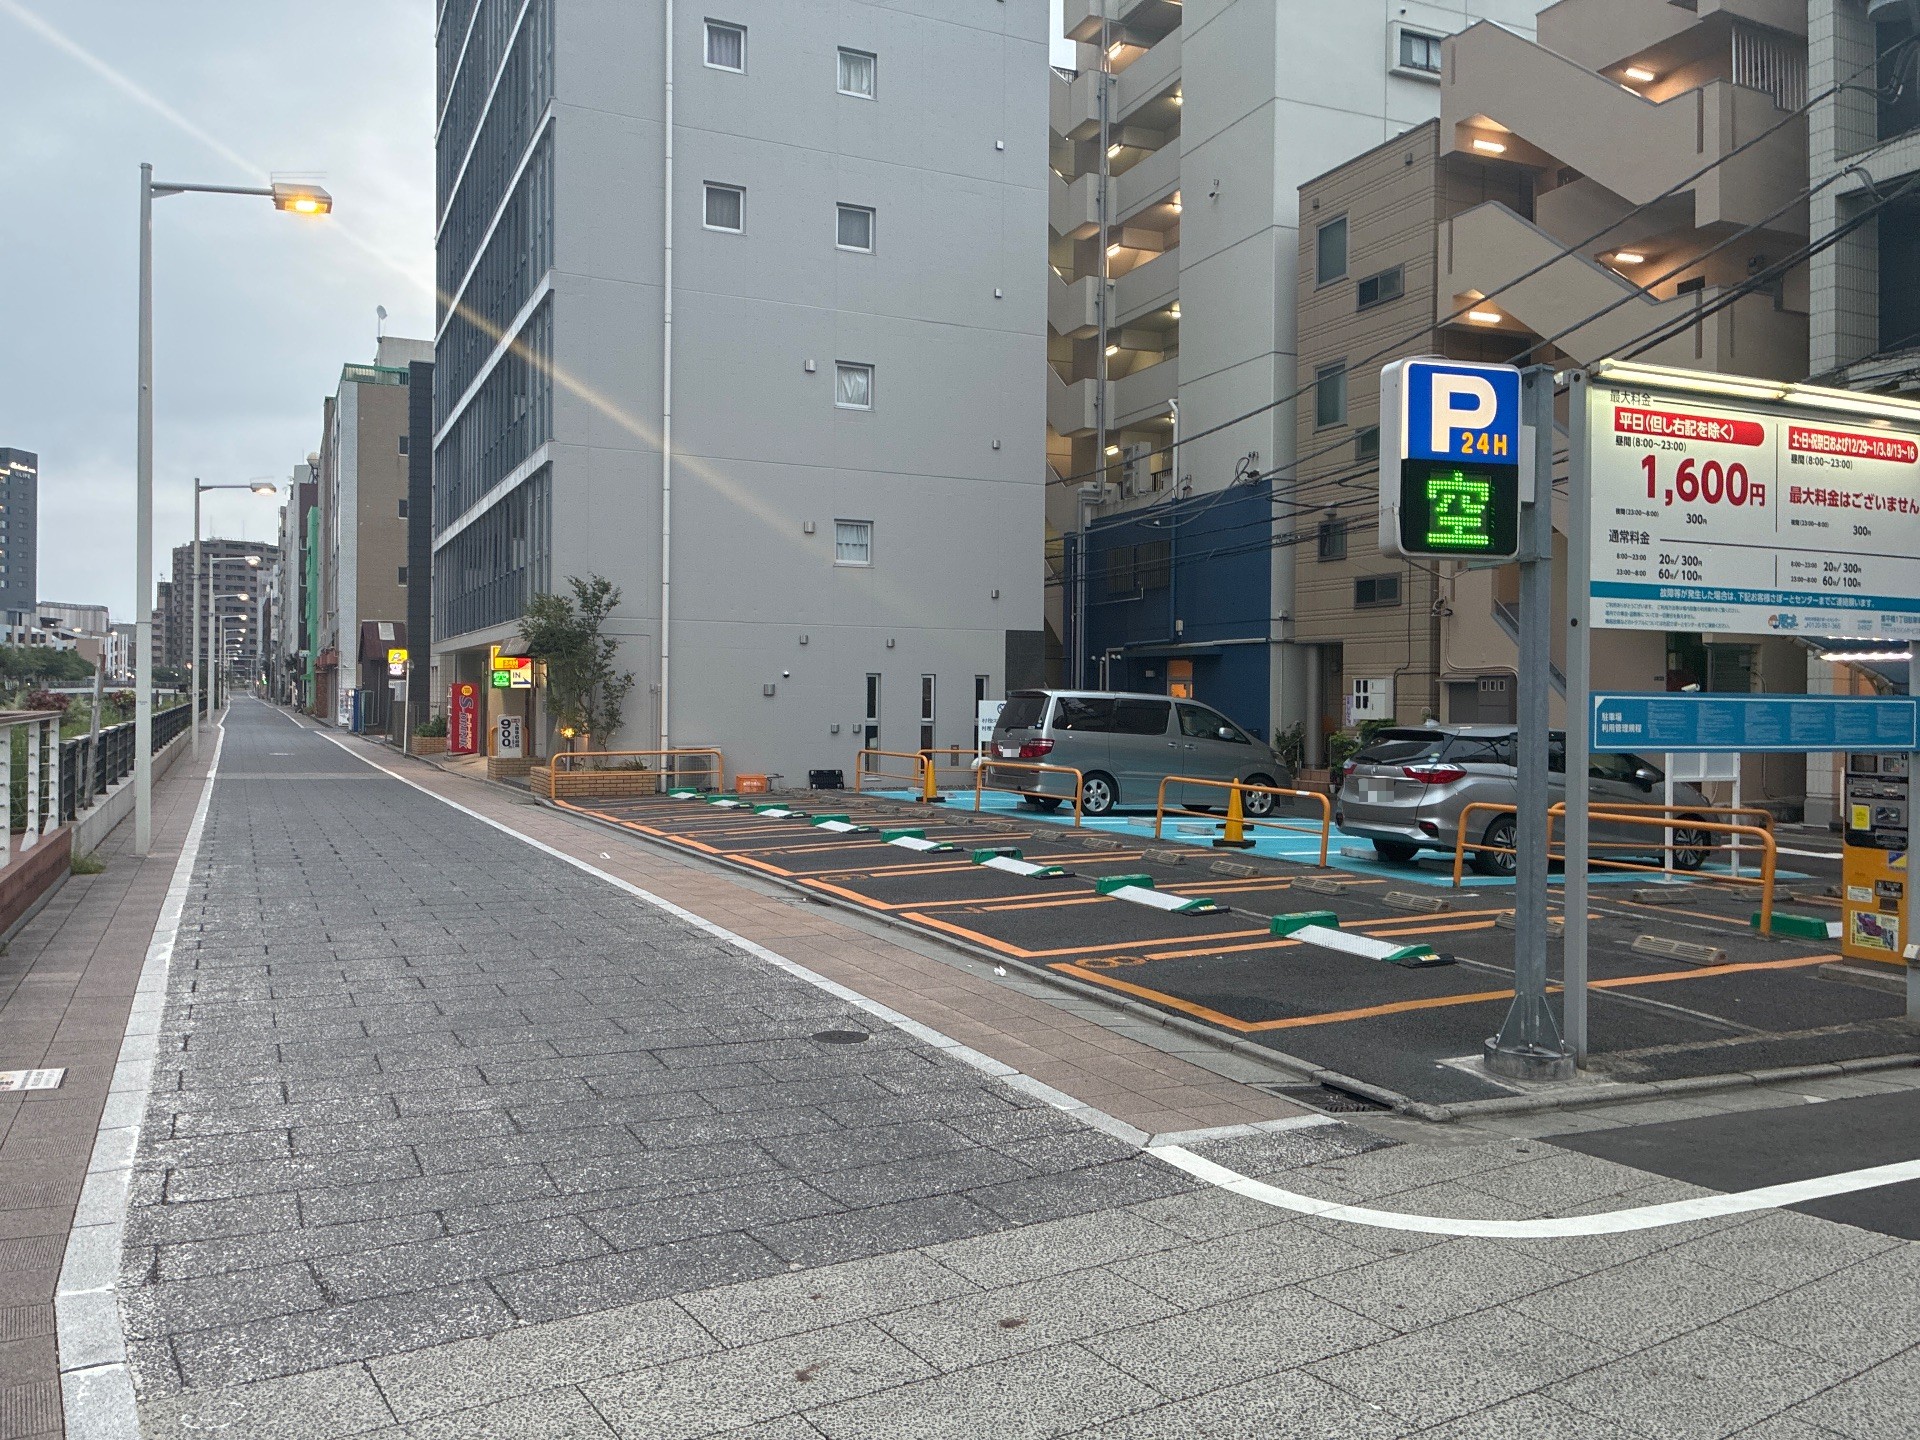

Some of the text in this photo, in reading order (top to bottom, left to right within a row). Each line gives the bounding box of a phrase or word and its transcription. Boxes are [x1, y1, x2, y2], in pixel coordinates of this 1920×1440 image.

[1610, 389, 1652, 406] 最大料金
[1432, 373, 1497, 452] P
[1619, 411, 1735, 441] 平日(但し右記を除く)
[1461, 432, 1508, 455] 24H
[1615, 435, 1687, 453] 昼間(8:00～23:00)
[1791, 454, 1853, 470] 昼間(8:00～23:00)
[1641, 454, 1766, 507] 1,600円
[1427, 471, 1490, 546] 空
[1789, 486, 1920, 515] 最大料金はございません
[1609, 529, 1650, 545] 通常料金
